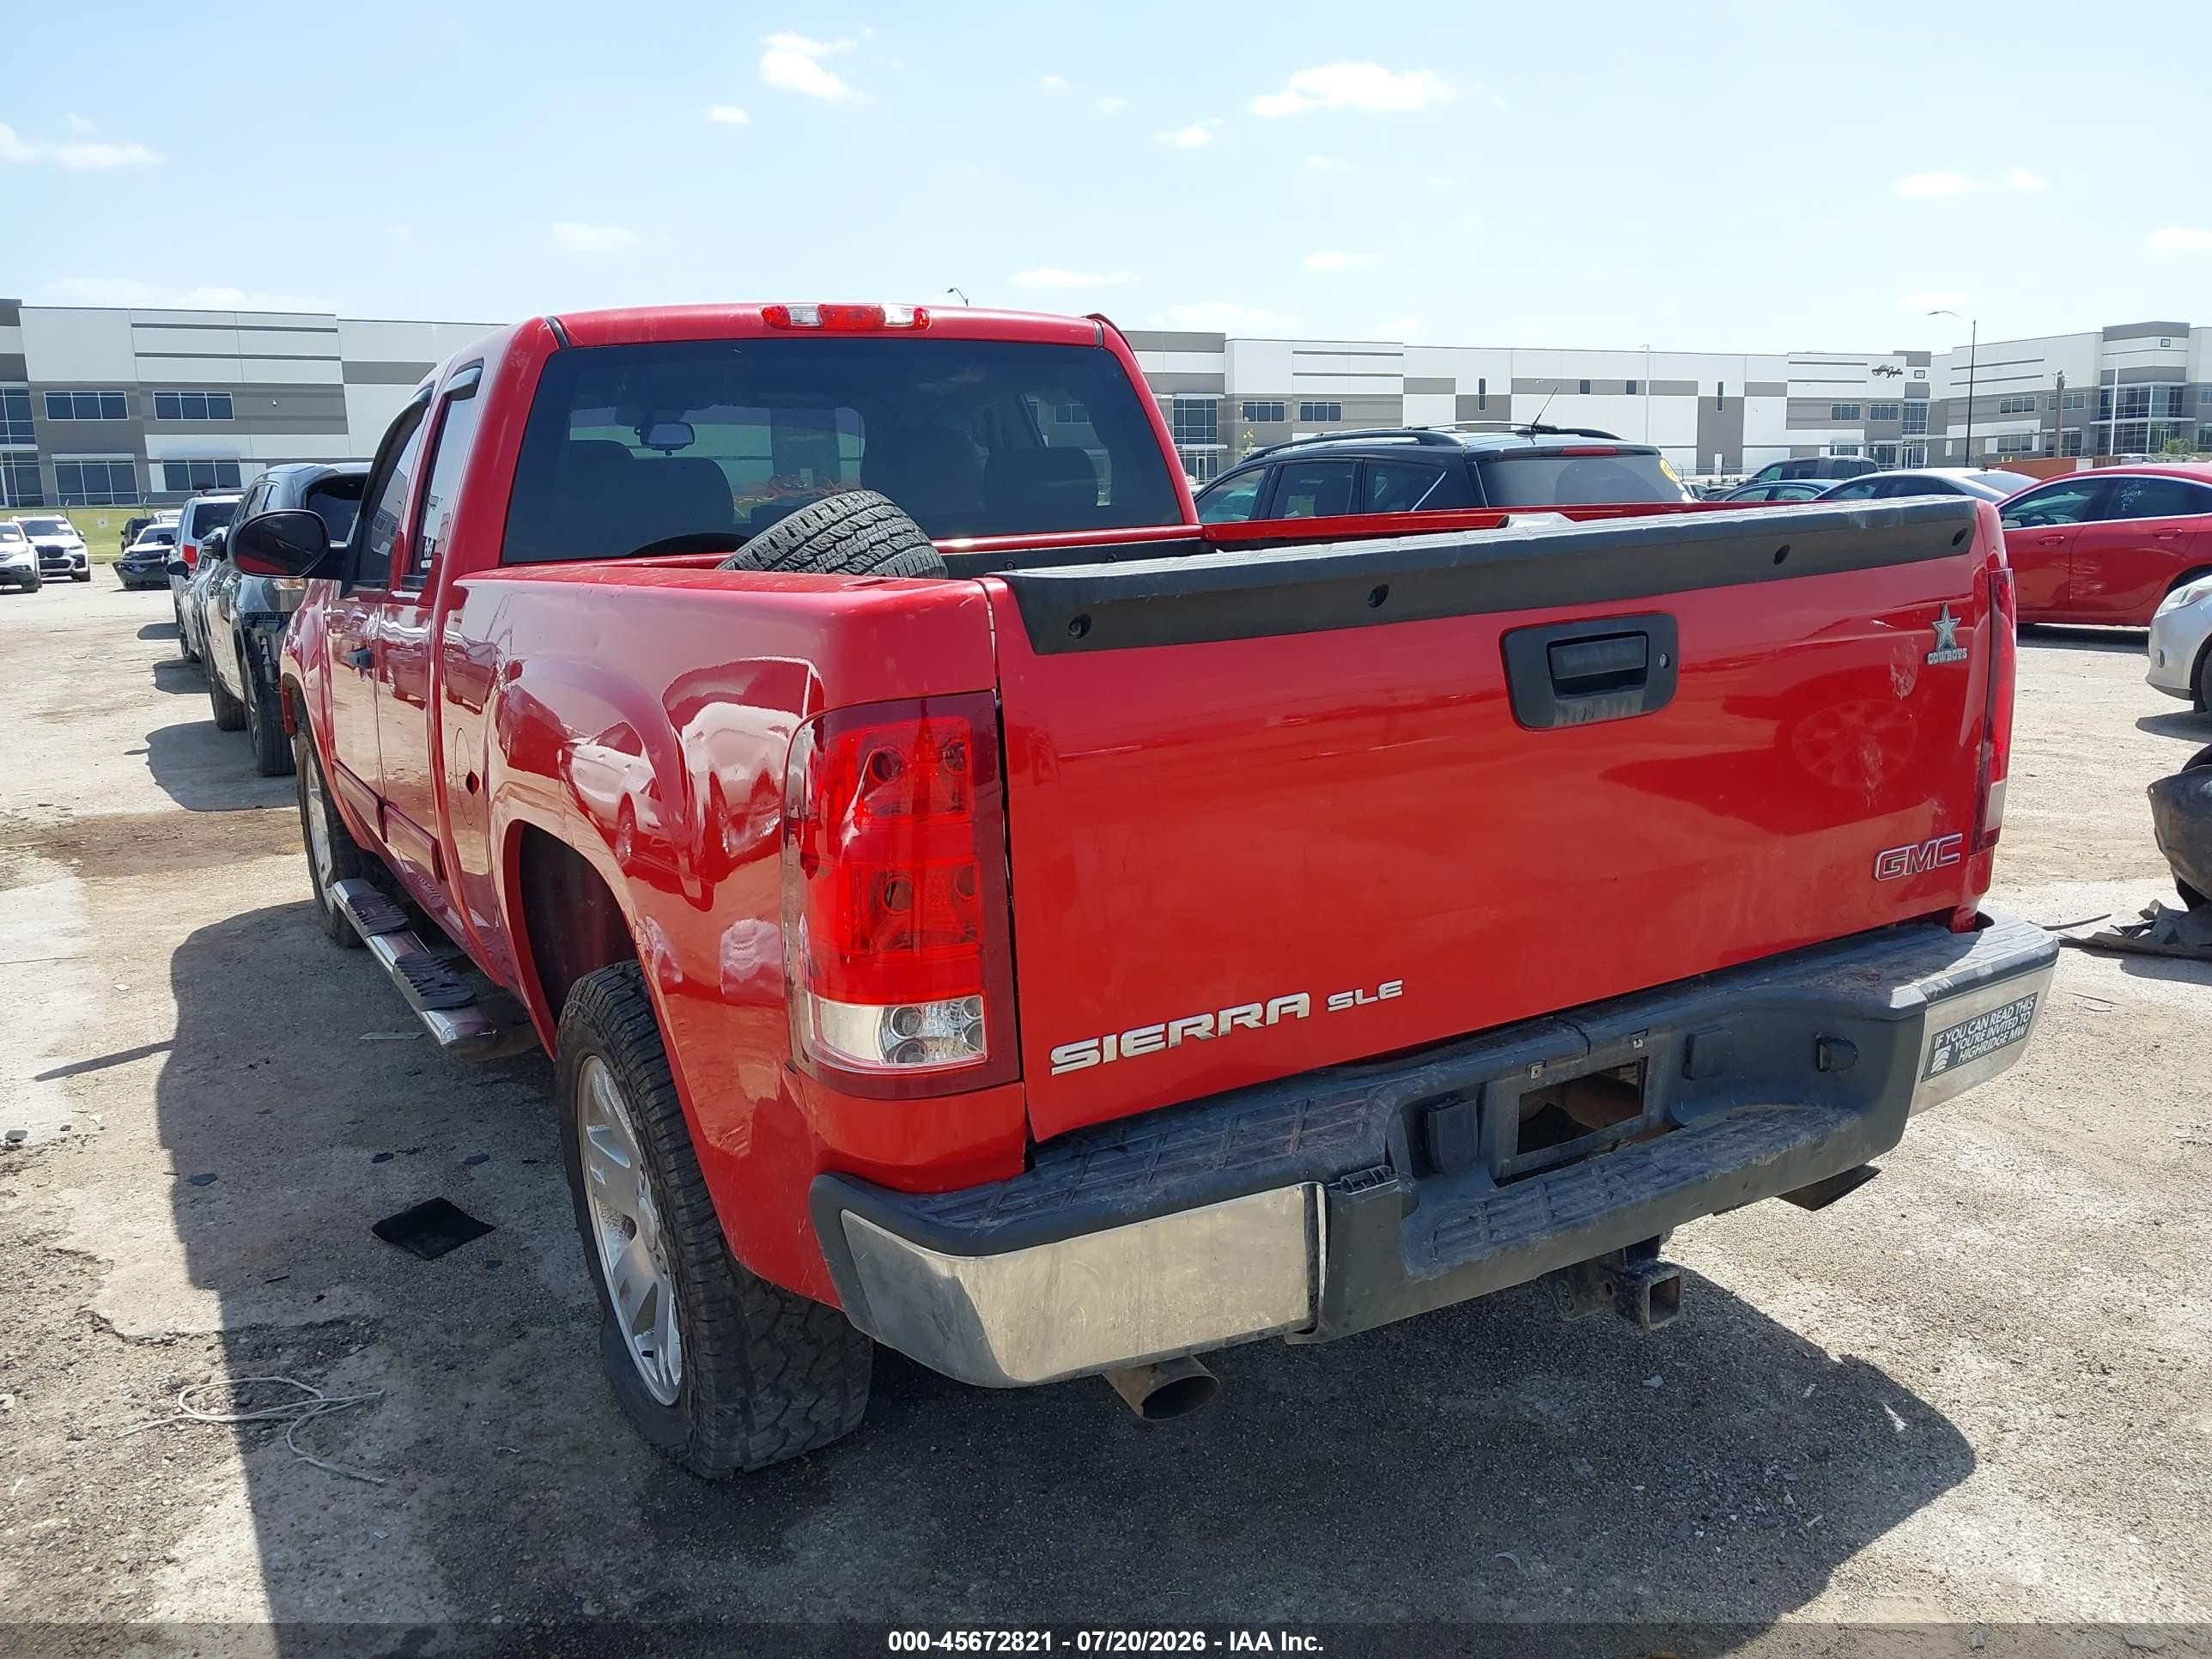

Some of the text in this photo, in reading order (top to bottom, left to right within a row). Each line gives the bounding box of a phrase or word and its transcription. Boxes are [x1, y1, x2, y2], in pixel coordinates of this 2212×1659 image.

[1927, 647, 1968, 665] COWBOYS
[1874, 833, 1963, 882] GMC
[1050, 979, 1404, 1076] SIERRA SLE
[1935, 996, 2034, 1049] IF YOU CAN READ THIS
[1954, 1011, 2031, 1052] YOU'RE INVITED TO
[1958, 1031, 2008, 1063] HIGHRIDGE
